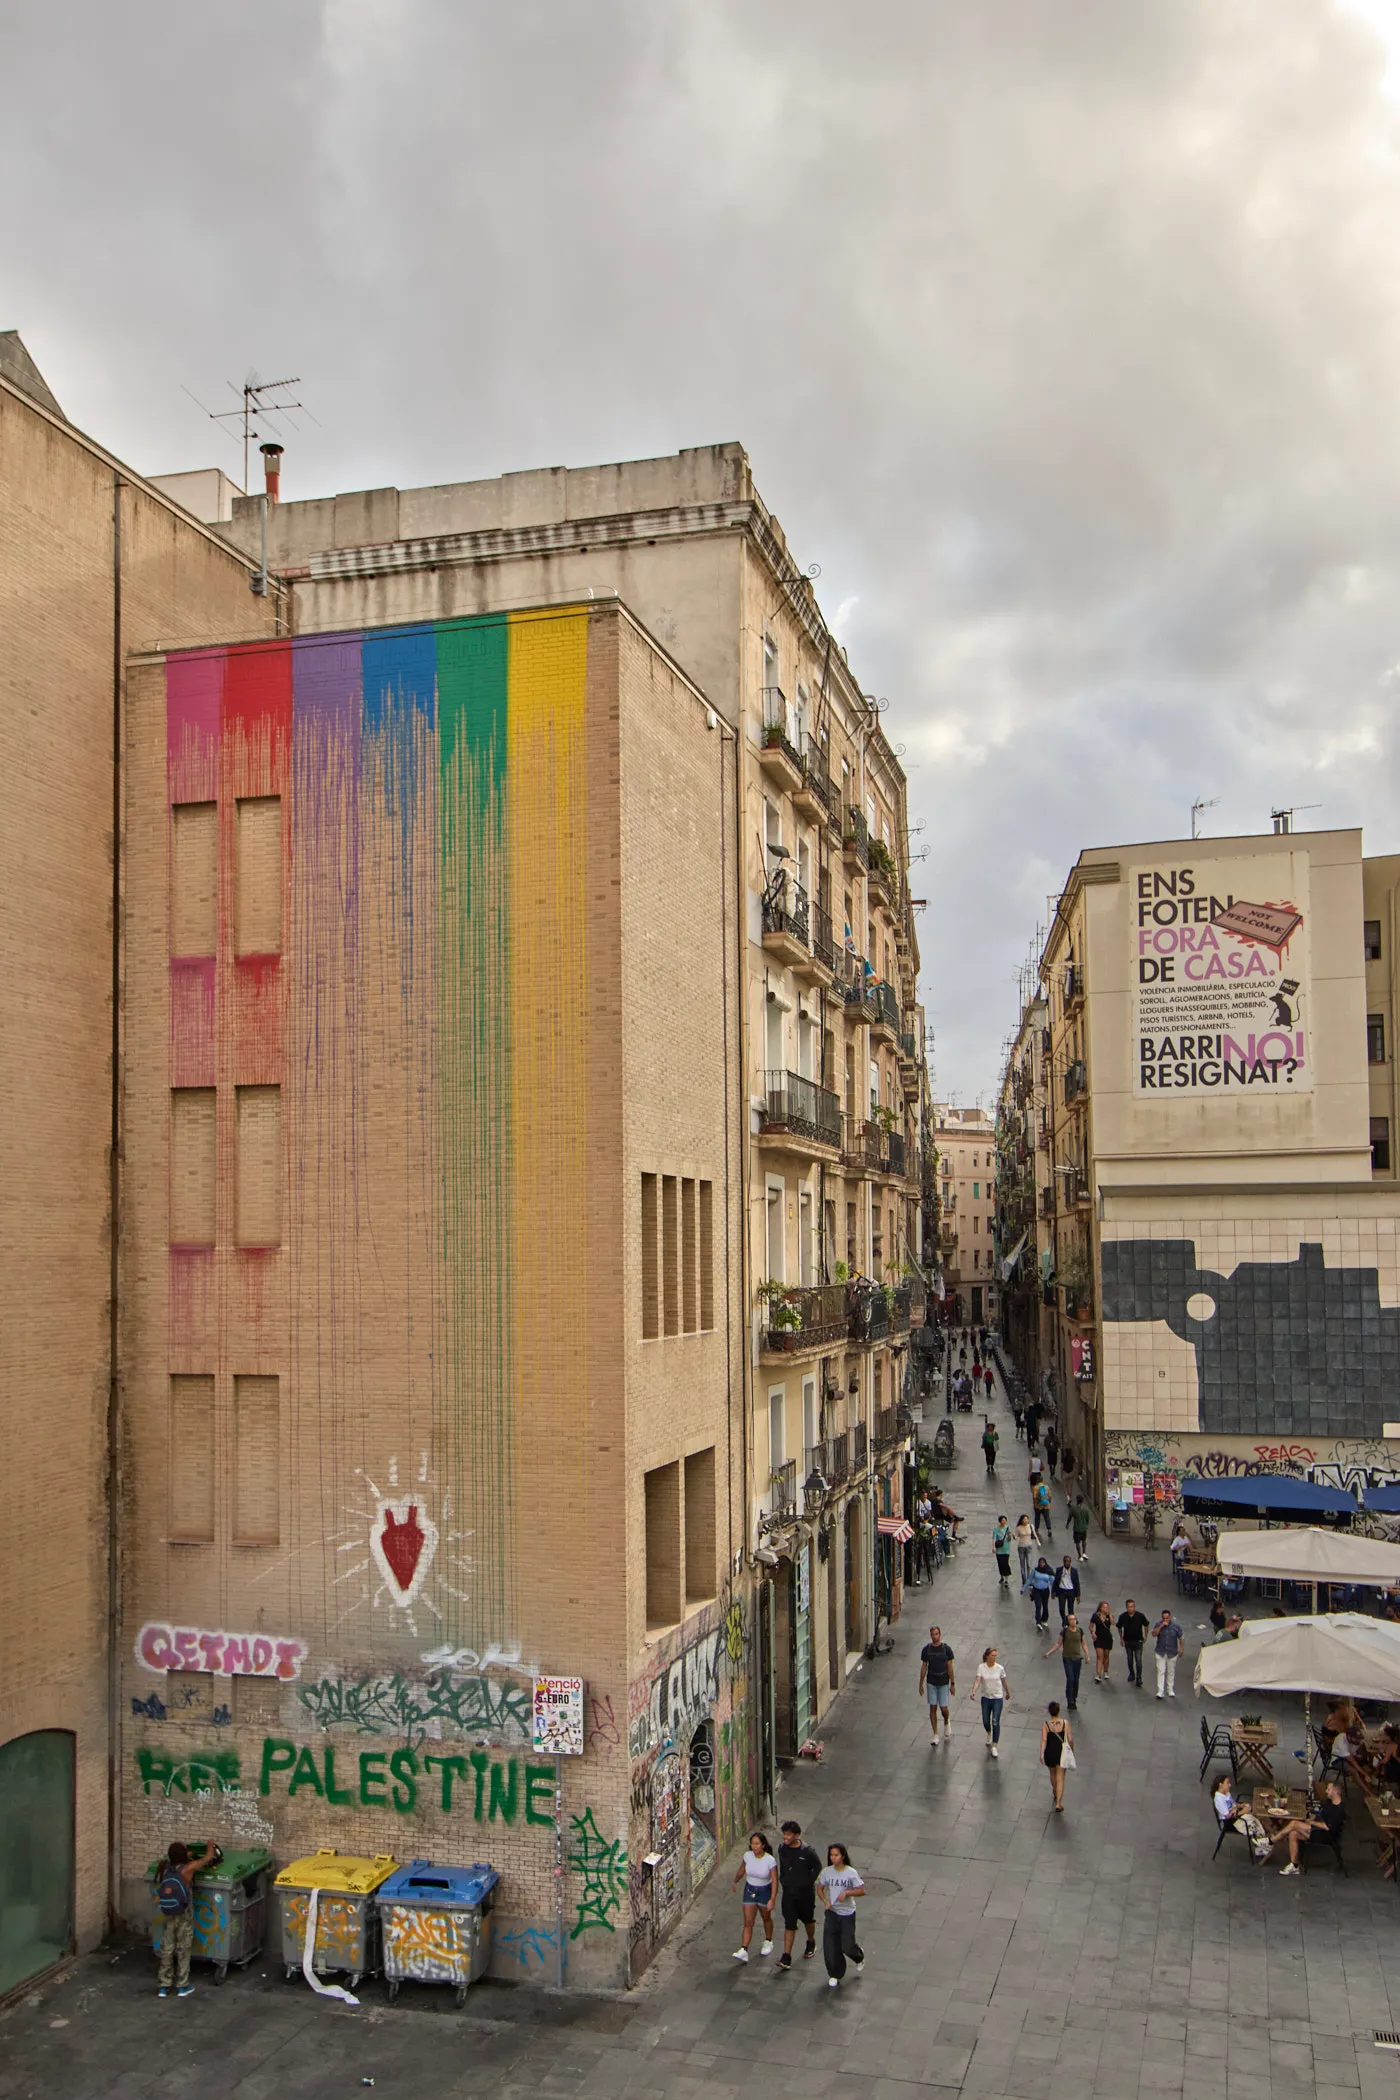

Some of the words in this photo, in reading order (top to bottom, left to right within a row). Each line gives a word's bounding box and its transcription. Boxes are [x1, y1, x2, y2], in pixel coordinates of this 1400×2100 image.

[1137, 869, 1195, 899] ENS
[1138, 895, 1233, 927] FOTEN
[1226, 912, 1285, 934] WELCOME
[1249, 910, 1274, 921] NOT
[1139, 925, 1220, 955] FORA
[1139, 956, 1175, 984] DE
[1184, 950, 1276, 981] CASA.
[1139, 997, 1168, 1005] SOROLL,
[1169, 994, 1233, 1003] AGLOMERACIONS,
[1234, 991, 1268, 999] BRUTÍCIA,
[1139, 1006, 1178, 1015] LLOGUERS
[1175, 1003, 1230, 1012] INASSEQUIBLES,
[1231, 1001, 1269, 1009] MOBBING,
[1139, 1016, 1160, 1024] PISOS
[1161, 1014, 1196, 1023] TURÍSTICS,
[1197, 1013, 1226, 1021] AIRBNB,
[1227, 1011, 1256, 1019] HOTELS,
[1140, 1034, 1222, 1062] BARRI
[1223, 1031, 1305, 1069] NO!
[1141, 1057, 1298, 1089] RESIGNAT?
[261, 1737, 558, 1827] PALESTINE
